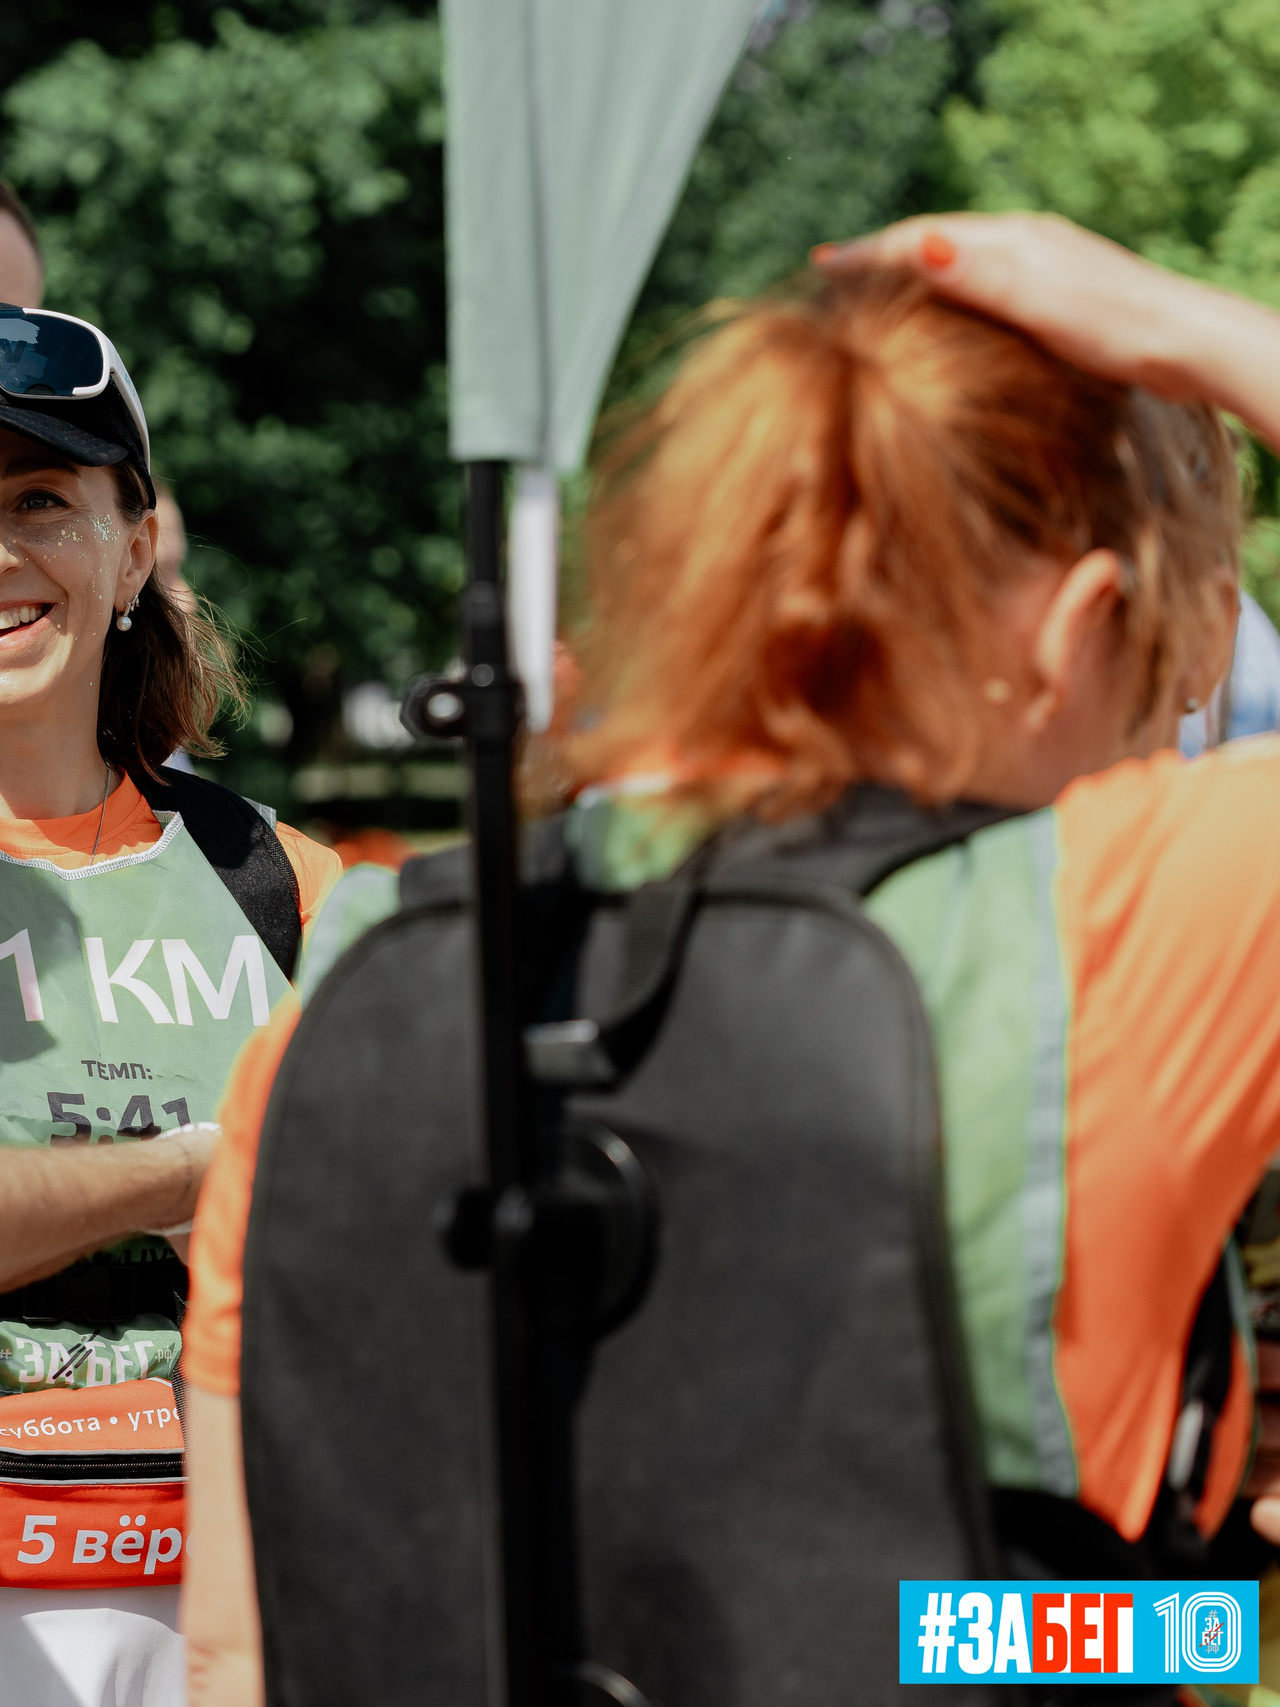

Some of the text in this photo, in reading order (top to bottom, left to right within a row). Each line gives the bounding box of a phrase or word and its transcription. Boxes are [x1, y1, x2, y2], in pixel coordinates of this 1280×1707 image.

[84, 935, 270, 1027] КМ
[81, 1059, 154, 1081] ТЕМП:
[17, 1514, 57, 1565] 5
